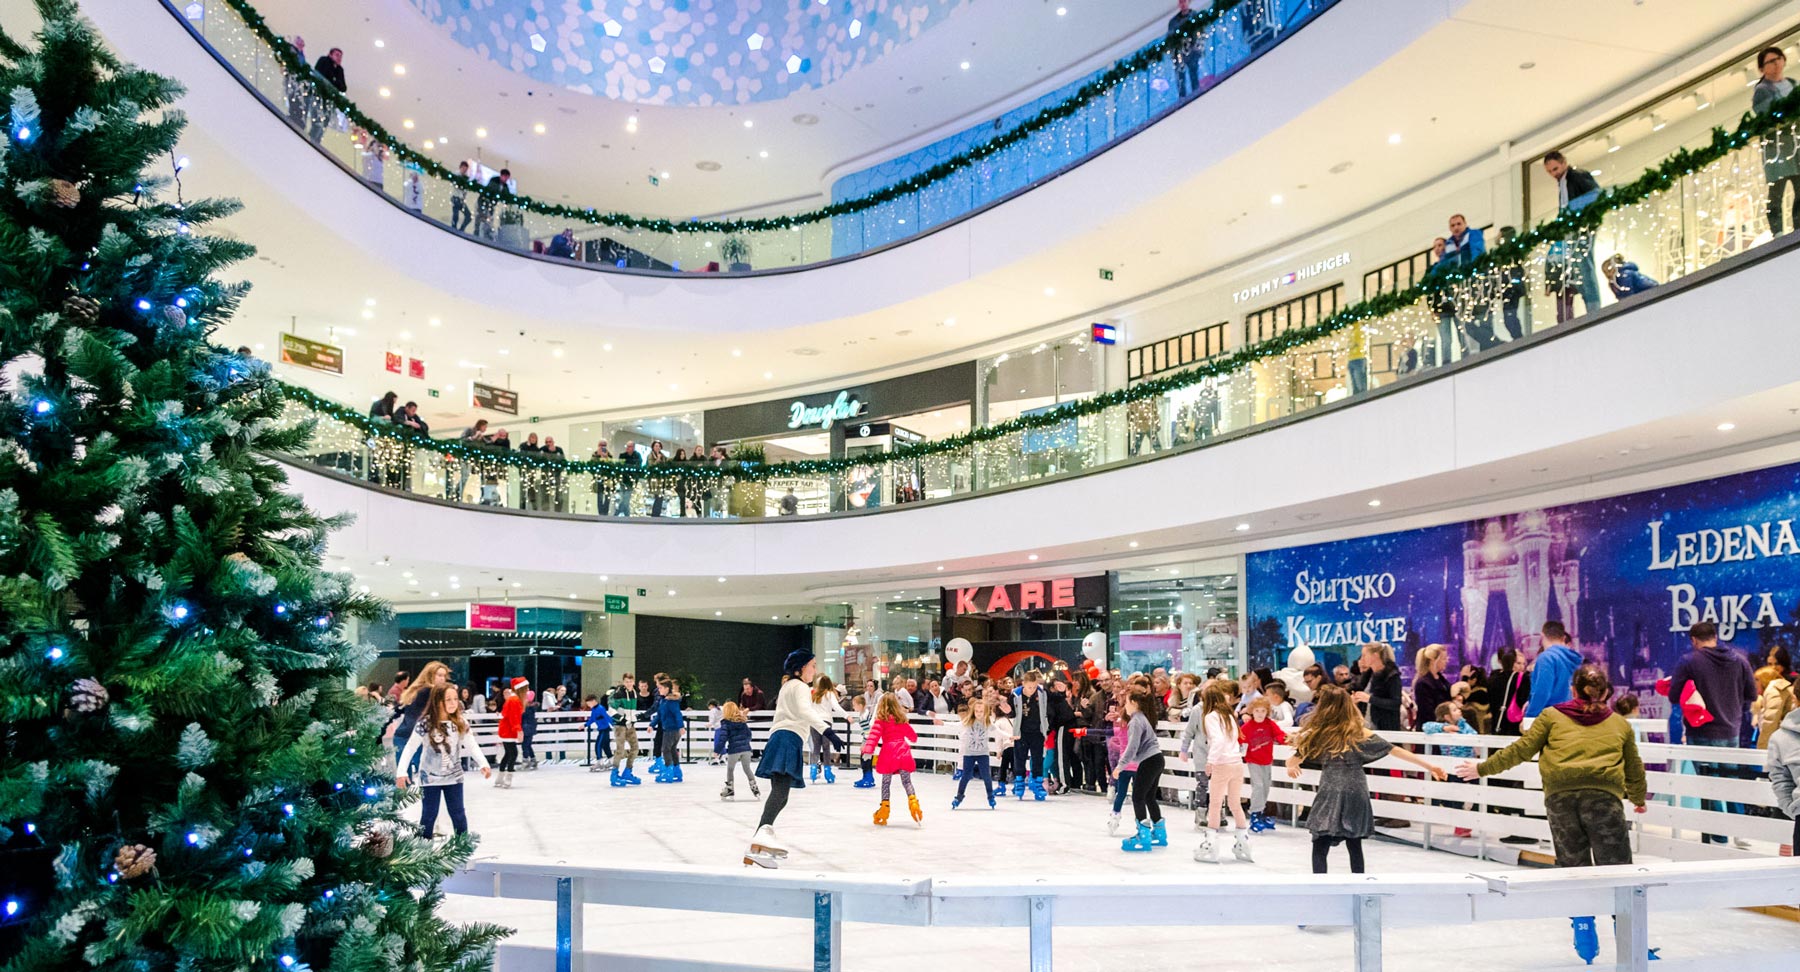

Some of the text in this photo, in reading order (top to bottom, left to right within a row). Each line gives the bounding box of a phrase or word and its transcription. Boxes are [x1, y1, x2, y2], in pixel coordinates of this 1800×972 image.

[1232, 252, 1351, 303] TOMMY HILFIGER
[788, 390, 862, 429] Douglas
[955, 578, 1076, 615] KARE
[1578, 923, 1589, 931] 38
